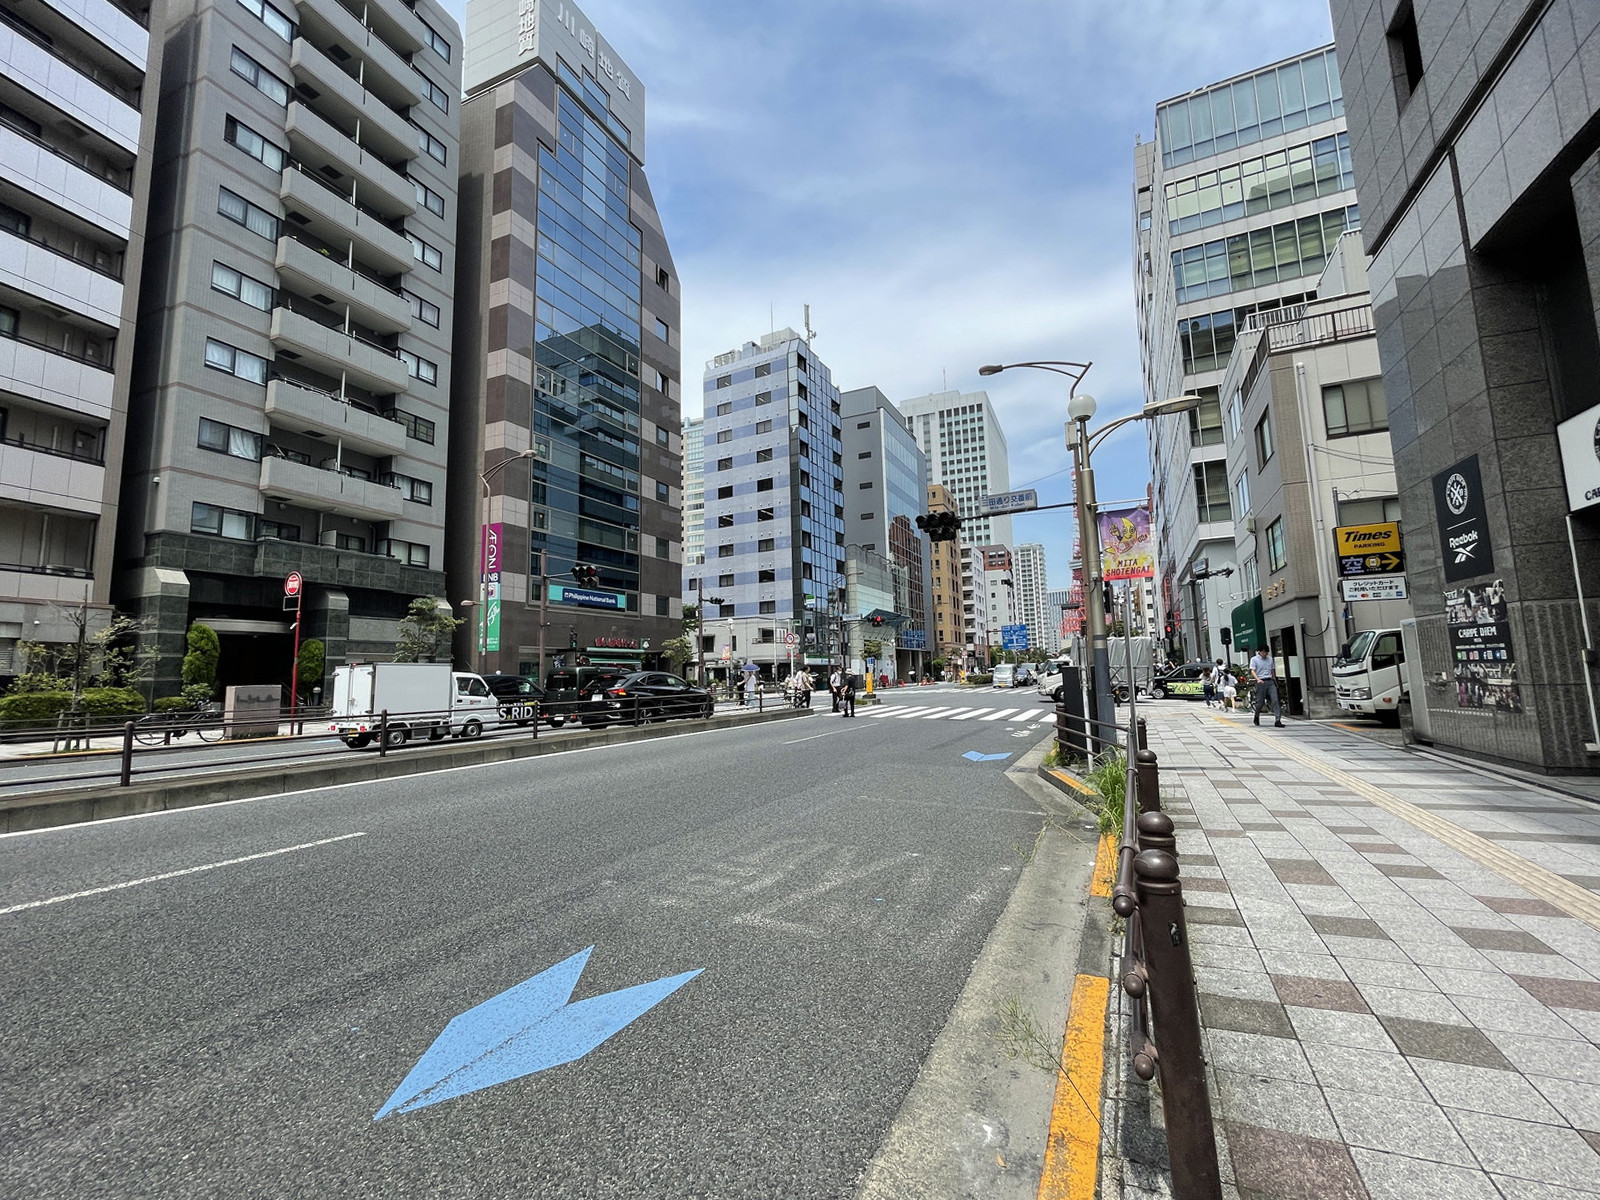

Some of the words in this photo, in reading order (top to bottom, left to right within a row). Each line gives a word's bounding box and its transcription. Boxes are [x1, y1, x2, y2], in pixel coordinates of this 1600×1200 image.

[981, 493, 1033, 507] 三田通り交番前
[1344, 530, 1393, 543] Times
[1448, 530, 1479, 549] Reebok
[1117, 558, 1138, 567] MITA
[1105, 565, 1151, 577] SHOTENGAI
[568, 592, 590, 601] Philippine
[589, 595, 606, 603] National
[1458, 627, 1479, 638] CARPE
[1479, 626, 1498, 637] DIEM
